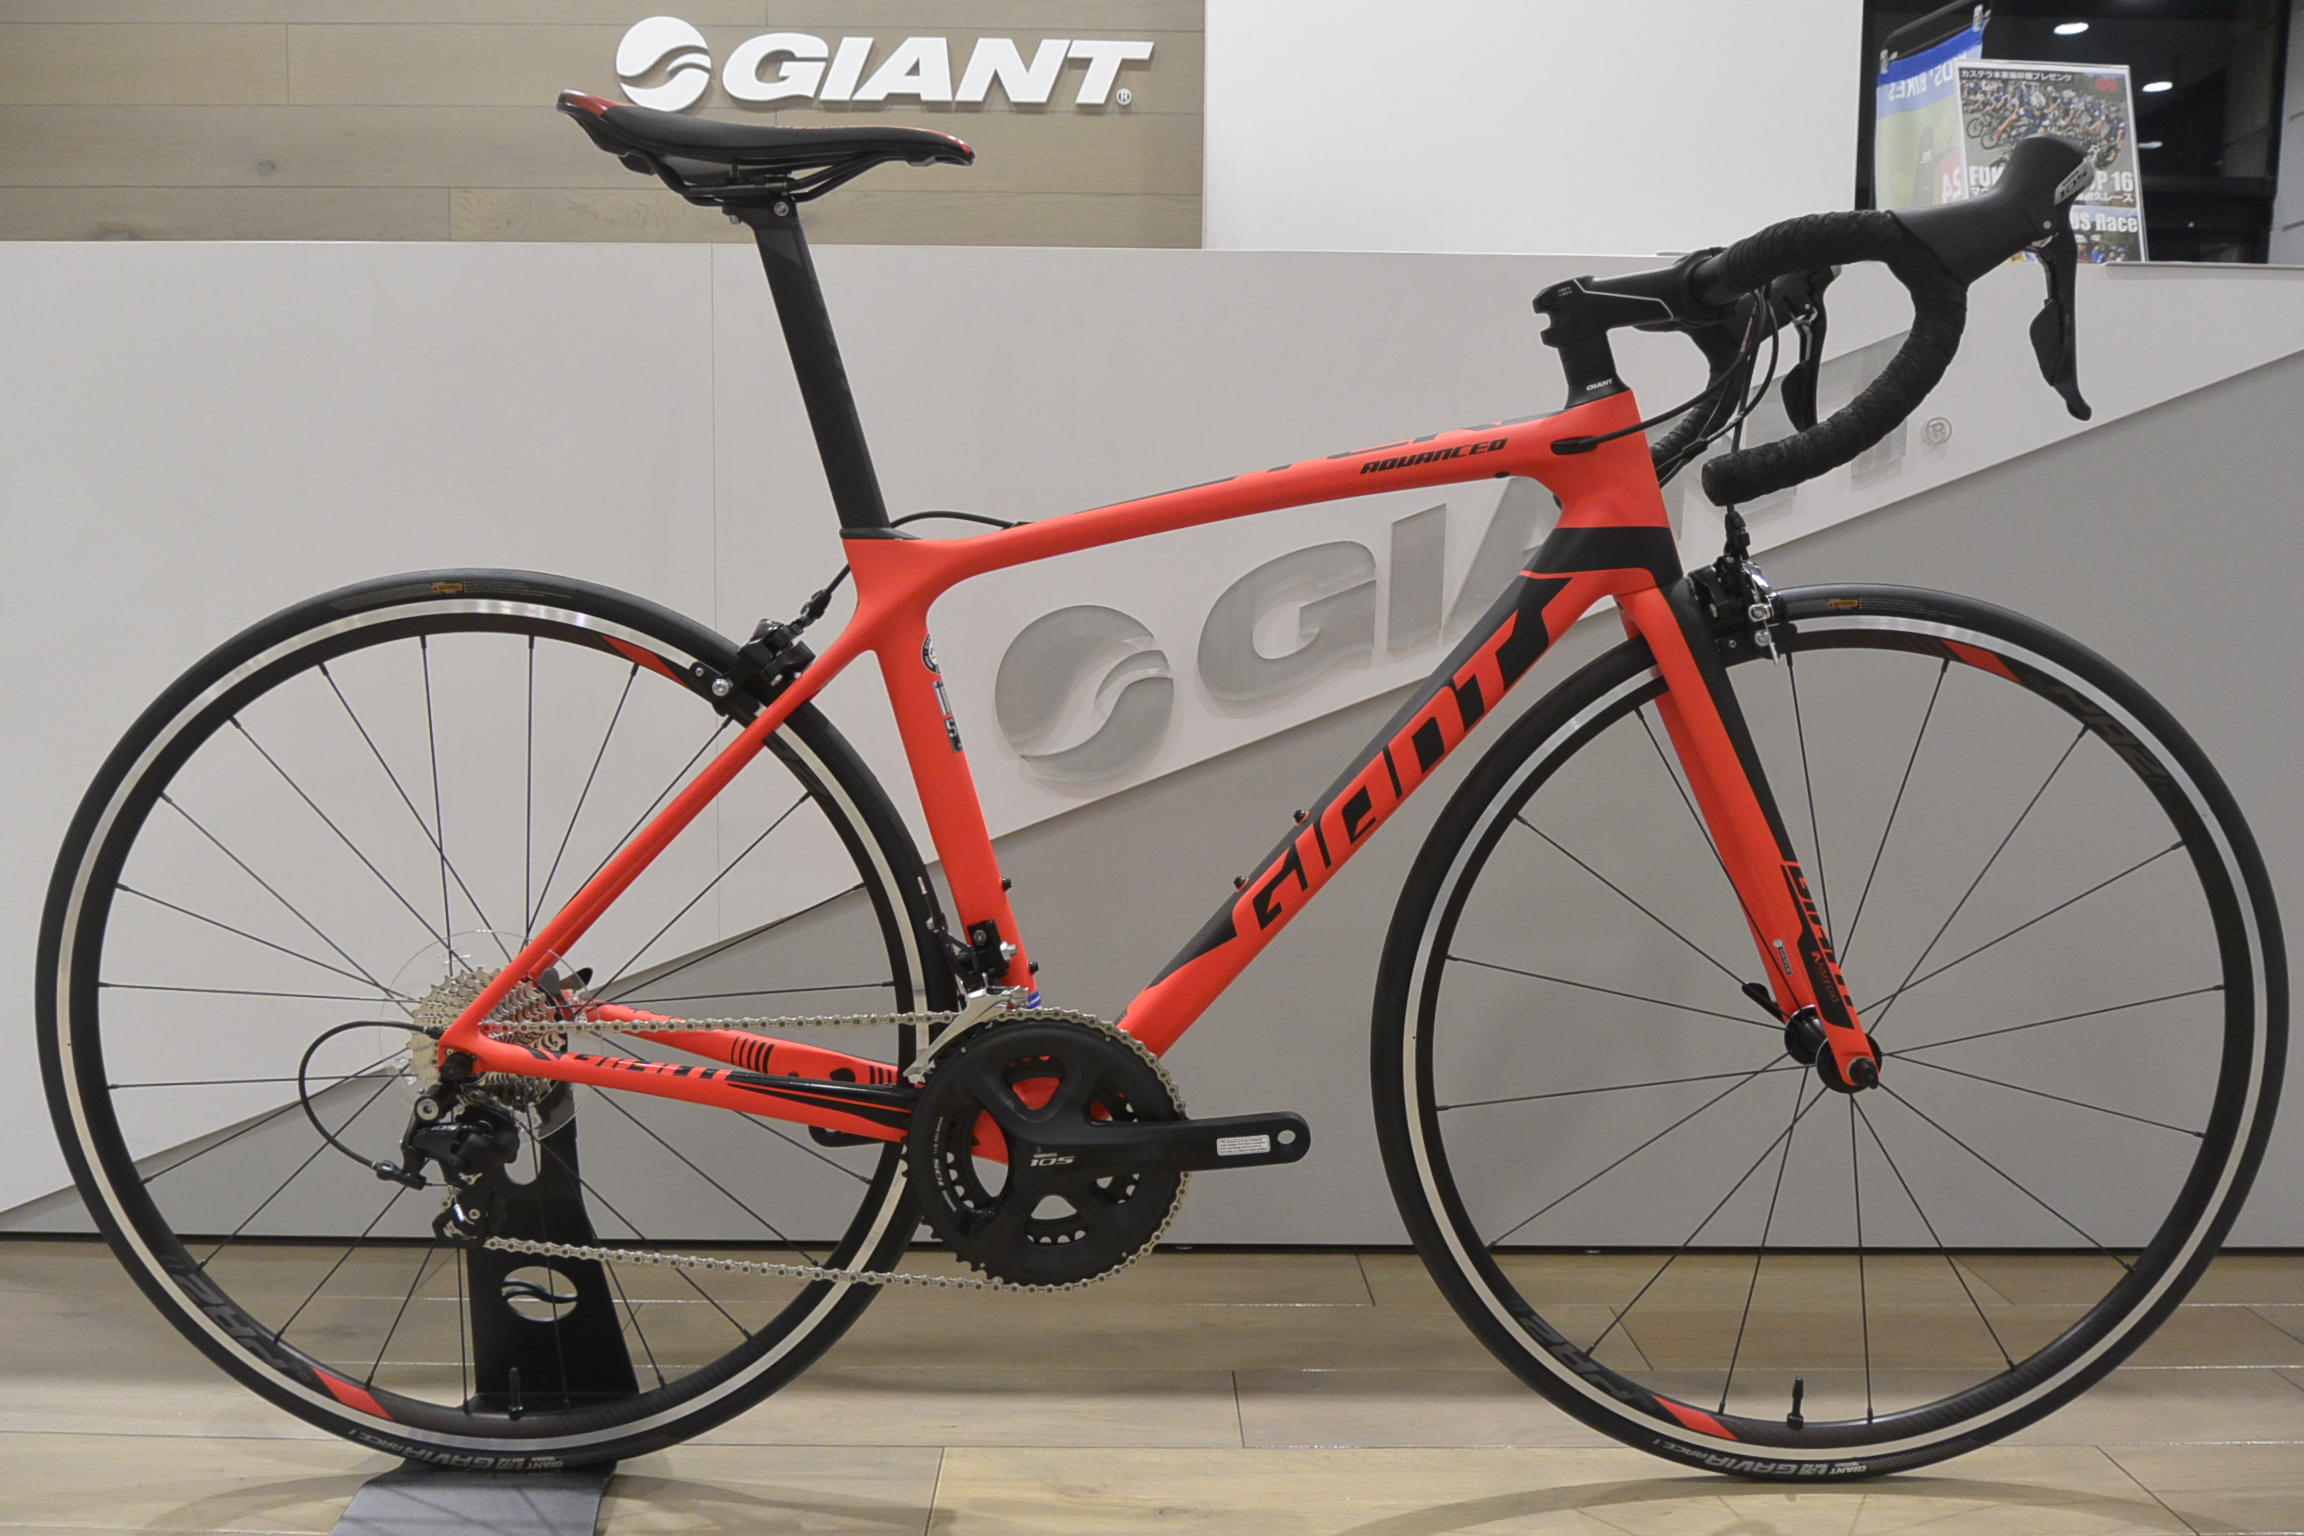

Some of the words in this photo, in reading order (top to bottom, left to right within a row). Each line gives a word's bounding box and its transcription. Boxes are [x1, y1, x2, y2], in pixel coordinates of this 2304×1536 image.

[722, 33, 1154, 105] GIANT
[2112, 170, 2135, 192] 16
[2095, 213, 2138, 232] Race
[1585, 378, 1613, 391] GIANT
[1360, 438, 1508, 475] ADVANCED
[1031, 1156, 1074, 1167] 105
[402, 1445, 501, 1469] GAVIA
[1704, 1453, 1798, 1475] GAVIA
